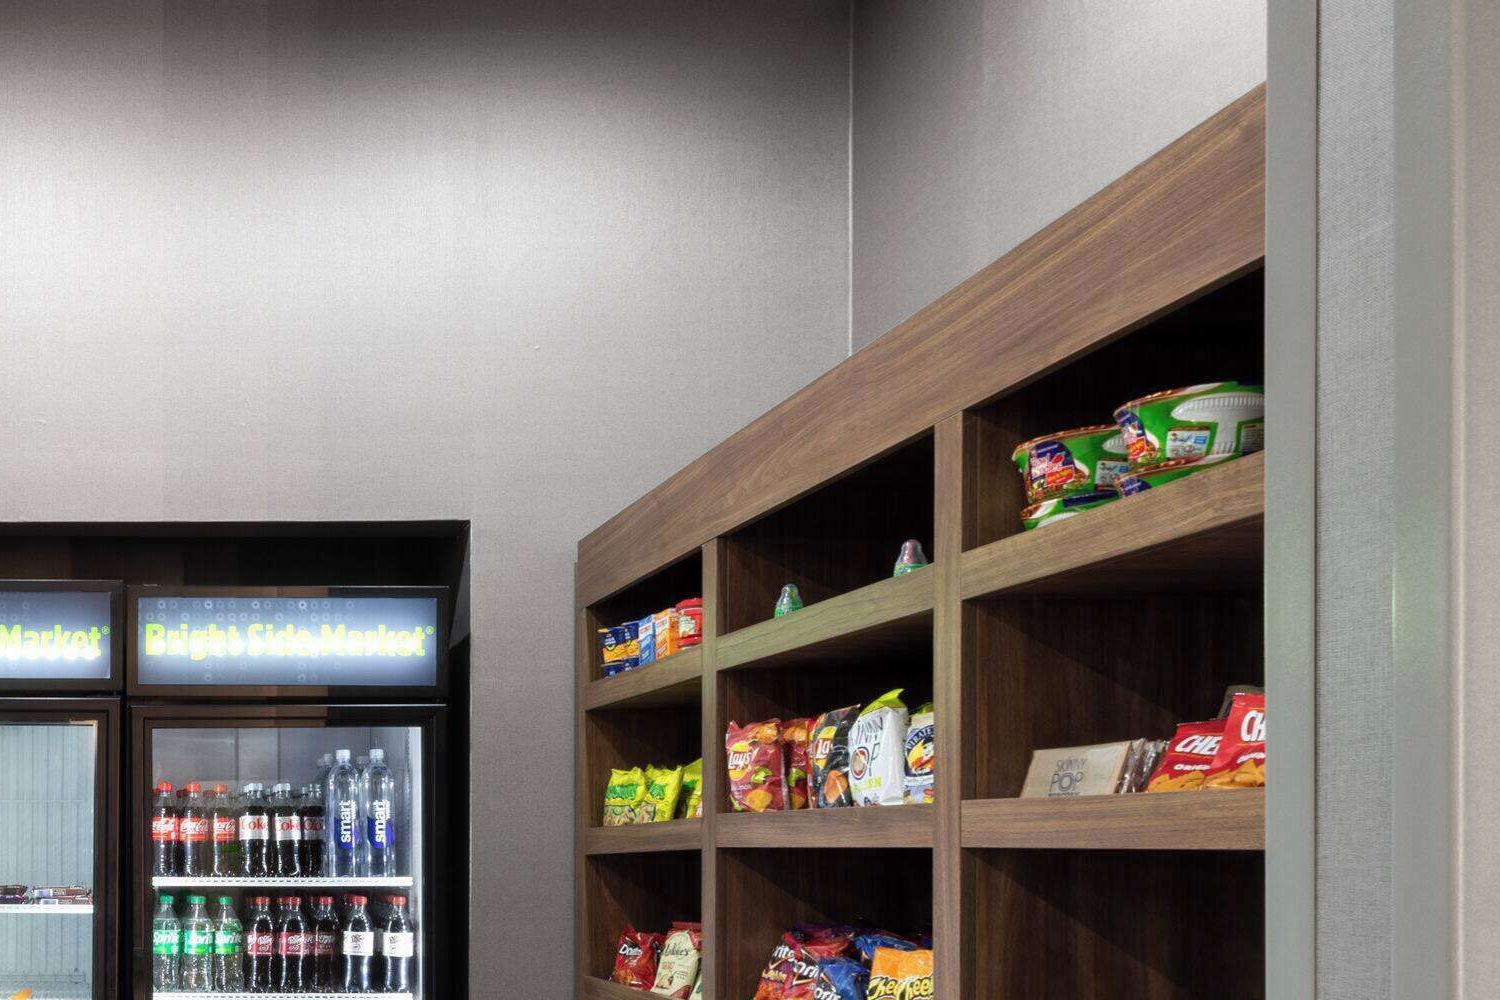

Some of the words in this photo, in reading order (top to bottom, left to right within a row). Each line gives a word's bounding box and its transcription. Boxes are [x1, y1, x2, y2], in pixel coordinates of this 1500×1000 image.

[144, 623, 238, 661] Bright
[246, 623, 311, 657] Side
[1049, 770, 1085, 793] POP
[339, 799, 351, 843] smart
[373, 799, 386, 843] smart
